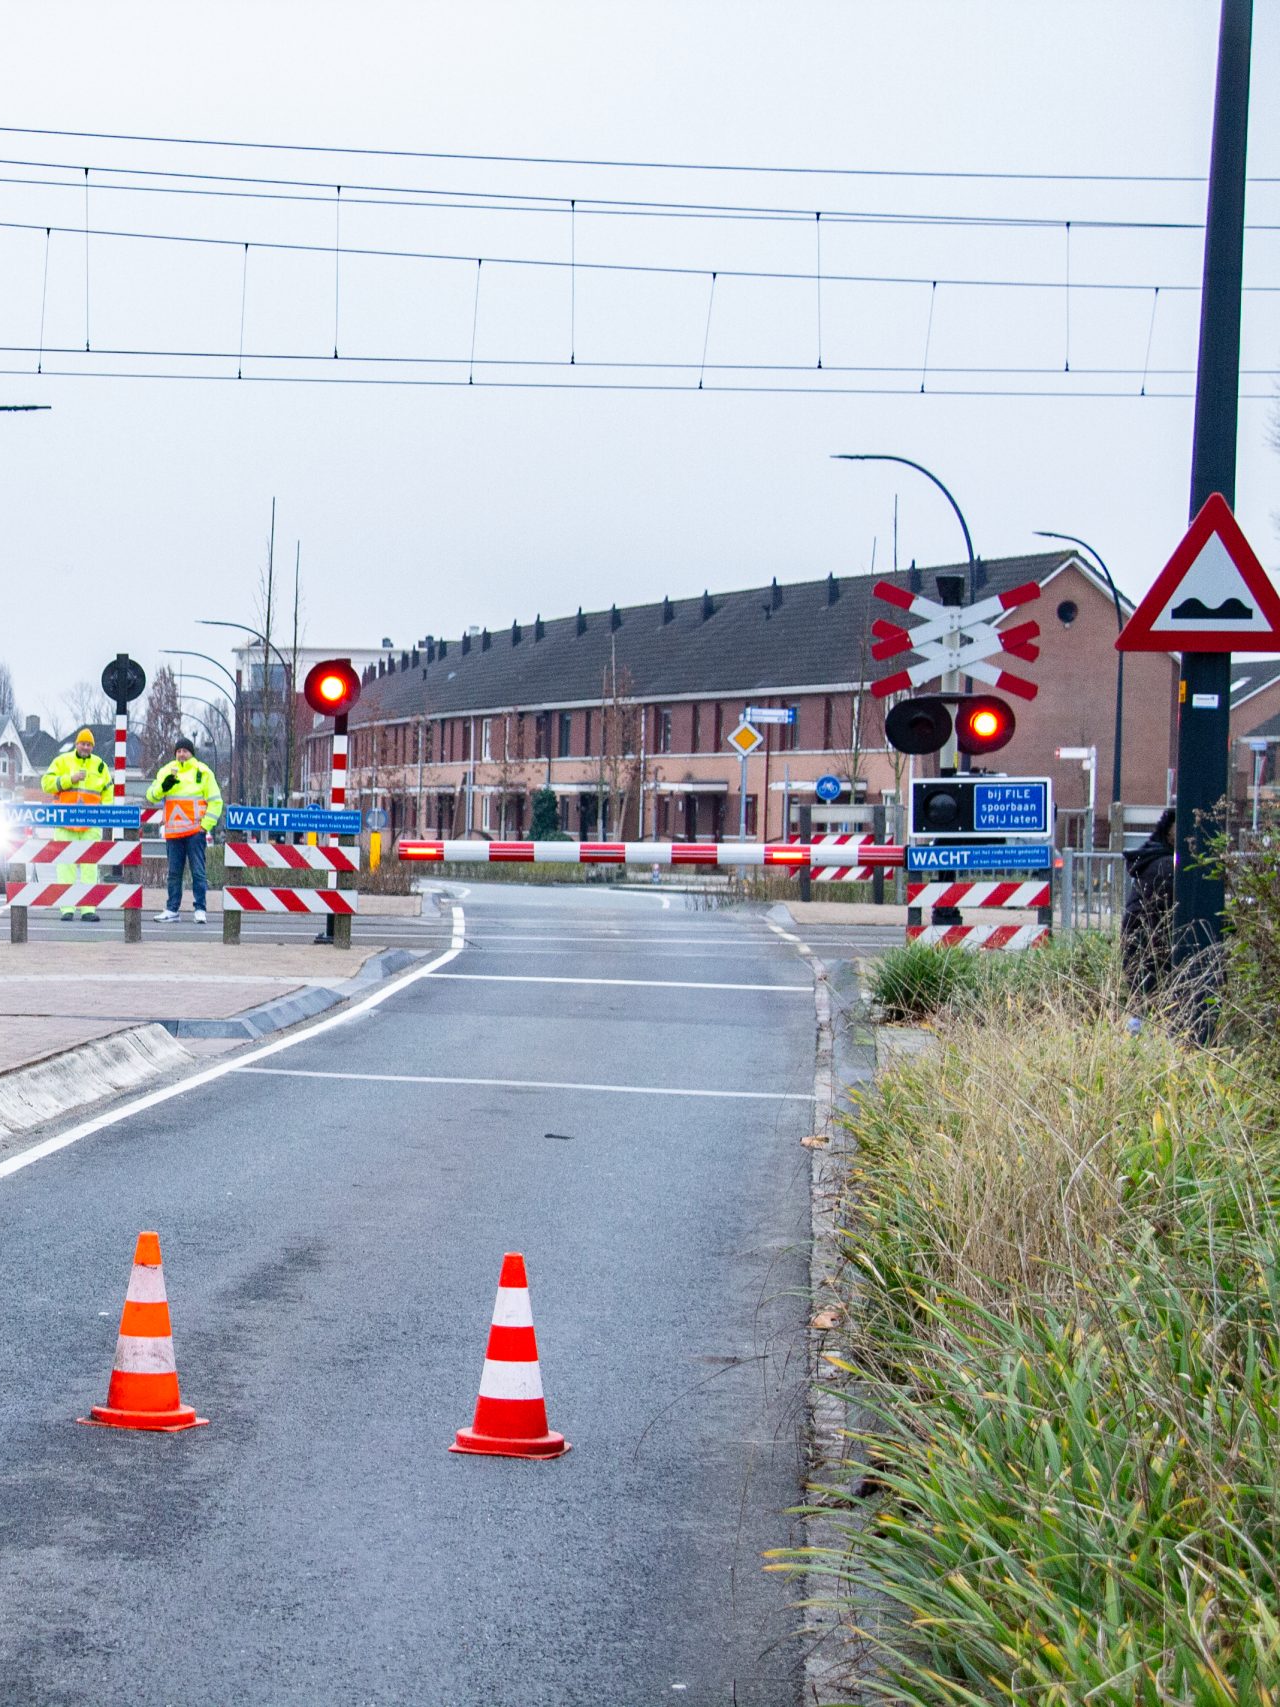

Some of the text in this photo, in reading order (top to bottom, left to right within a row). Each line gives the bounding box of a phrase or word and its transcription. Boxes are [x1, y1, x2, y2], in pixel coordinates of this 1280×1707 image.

[988, 789, 1030, 801] bij FILE
[981, 802, 1036, 813] spoorbaan
[6, 808, 67, 823] WACHT
[229, 811, 290, 827] WACHT
[980, 814, 1038, 824] VRIJ laten
[912, 851, 971, 866] WACHT
